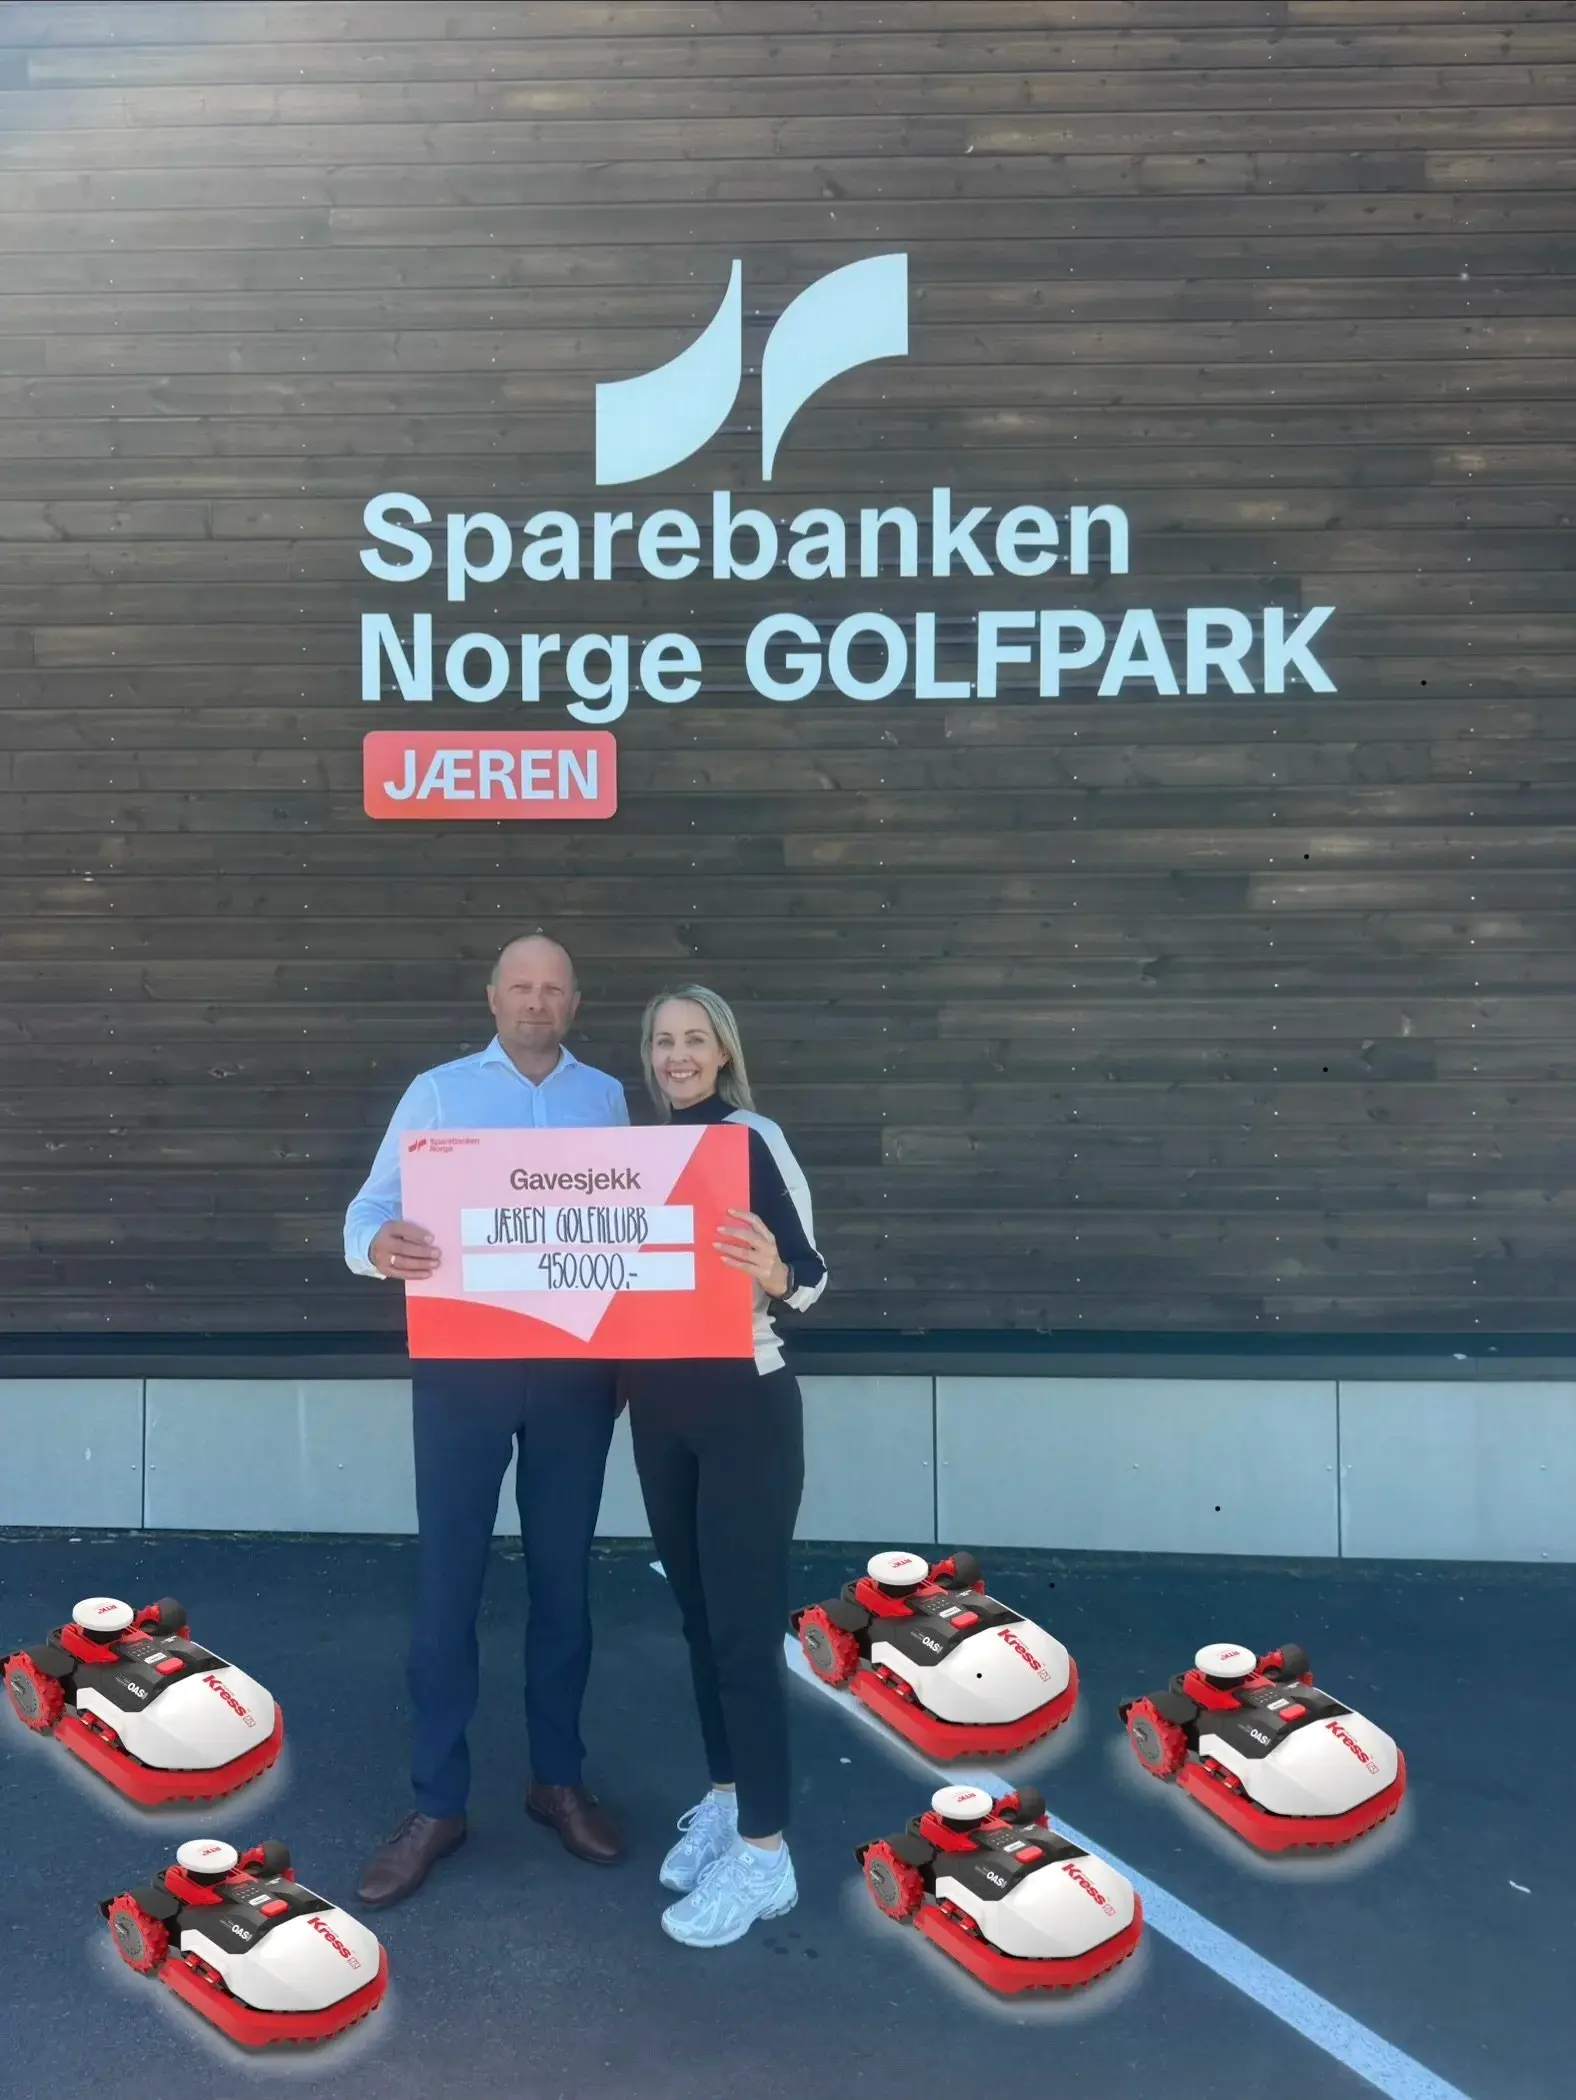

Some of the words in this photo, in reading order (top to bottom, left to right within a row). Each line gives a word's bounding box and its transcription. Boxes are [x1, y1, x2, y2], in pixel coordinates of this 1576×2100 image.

[360, 488, 1129, 602] Sparebanken
[361, 613, 702, 724] Norge
[745, 606, 1338, 702] GOLFPARK
[383, 748, 599, 801] JÆREN
[509, 1167, 642, 1195] Gavesjekk
[487, 1206, 546, 1245] JÆREN
[556, 1206, 649, 1245] GOLFKLUBB
[537, 1252, 638, 1290] 450.000,-
[998, 1628, 1042, 1672] Kress
[203, 1674, 248, 1718] Kress
[1326, 1720, 1371, 1765] Kress
[1062, 1862, 1107, 1907] Kress
[307, 1916, 352, 1960] Kress
